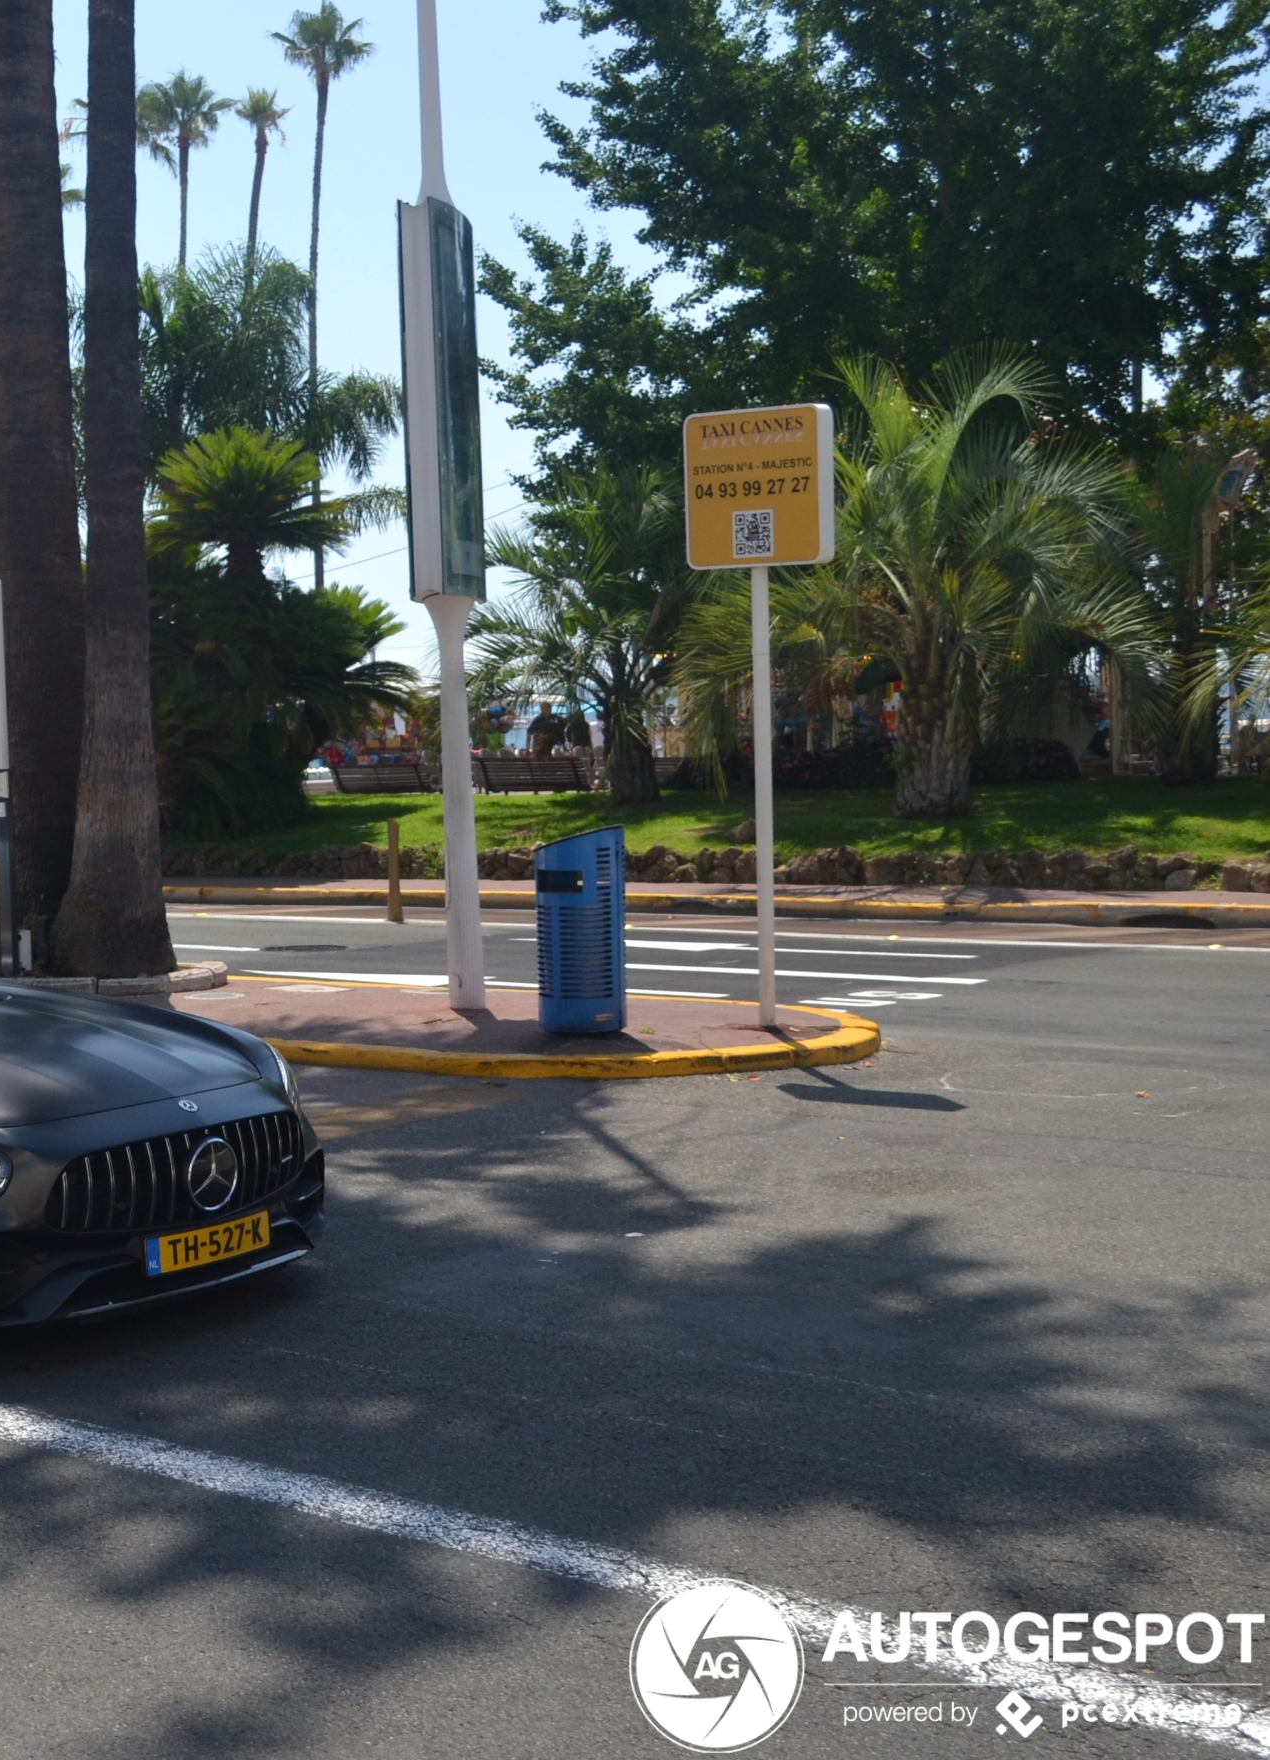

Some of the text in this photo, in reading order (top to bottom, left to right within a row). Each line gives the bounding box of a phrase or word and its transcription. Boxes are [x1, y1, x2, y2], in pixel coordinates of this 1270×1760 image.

[700, 416, 804, 439] TAXI CANNES
[693, 463, 734, 475] STATION
[762, 457, 812, 469] MAJESTIC
[695, 476, 811, 500] 04 93 99 27 27
[149, 1217, 263, 1269] NL TH-527-K
